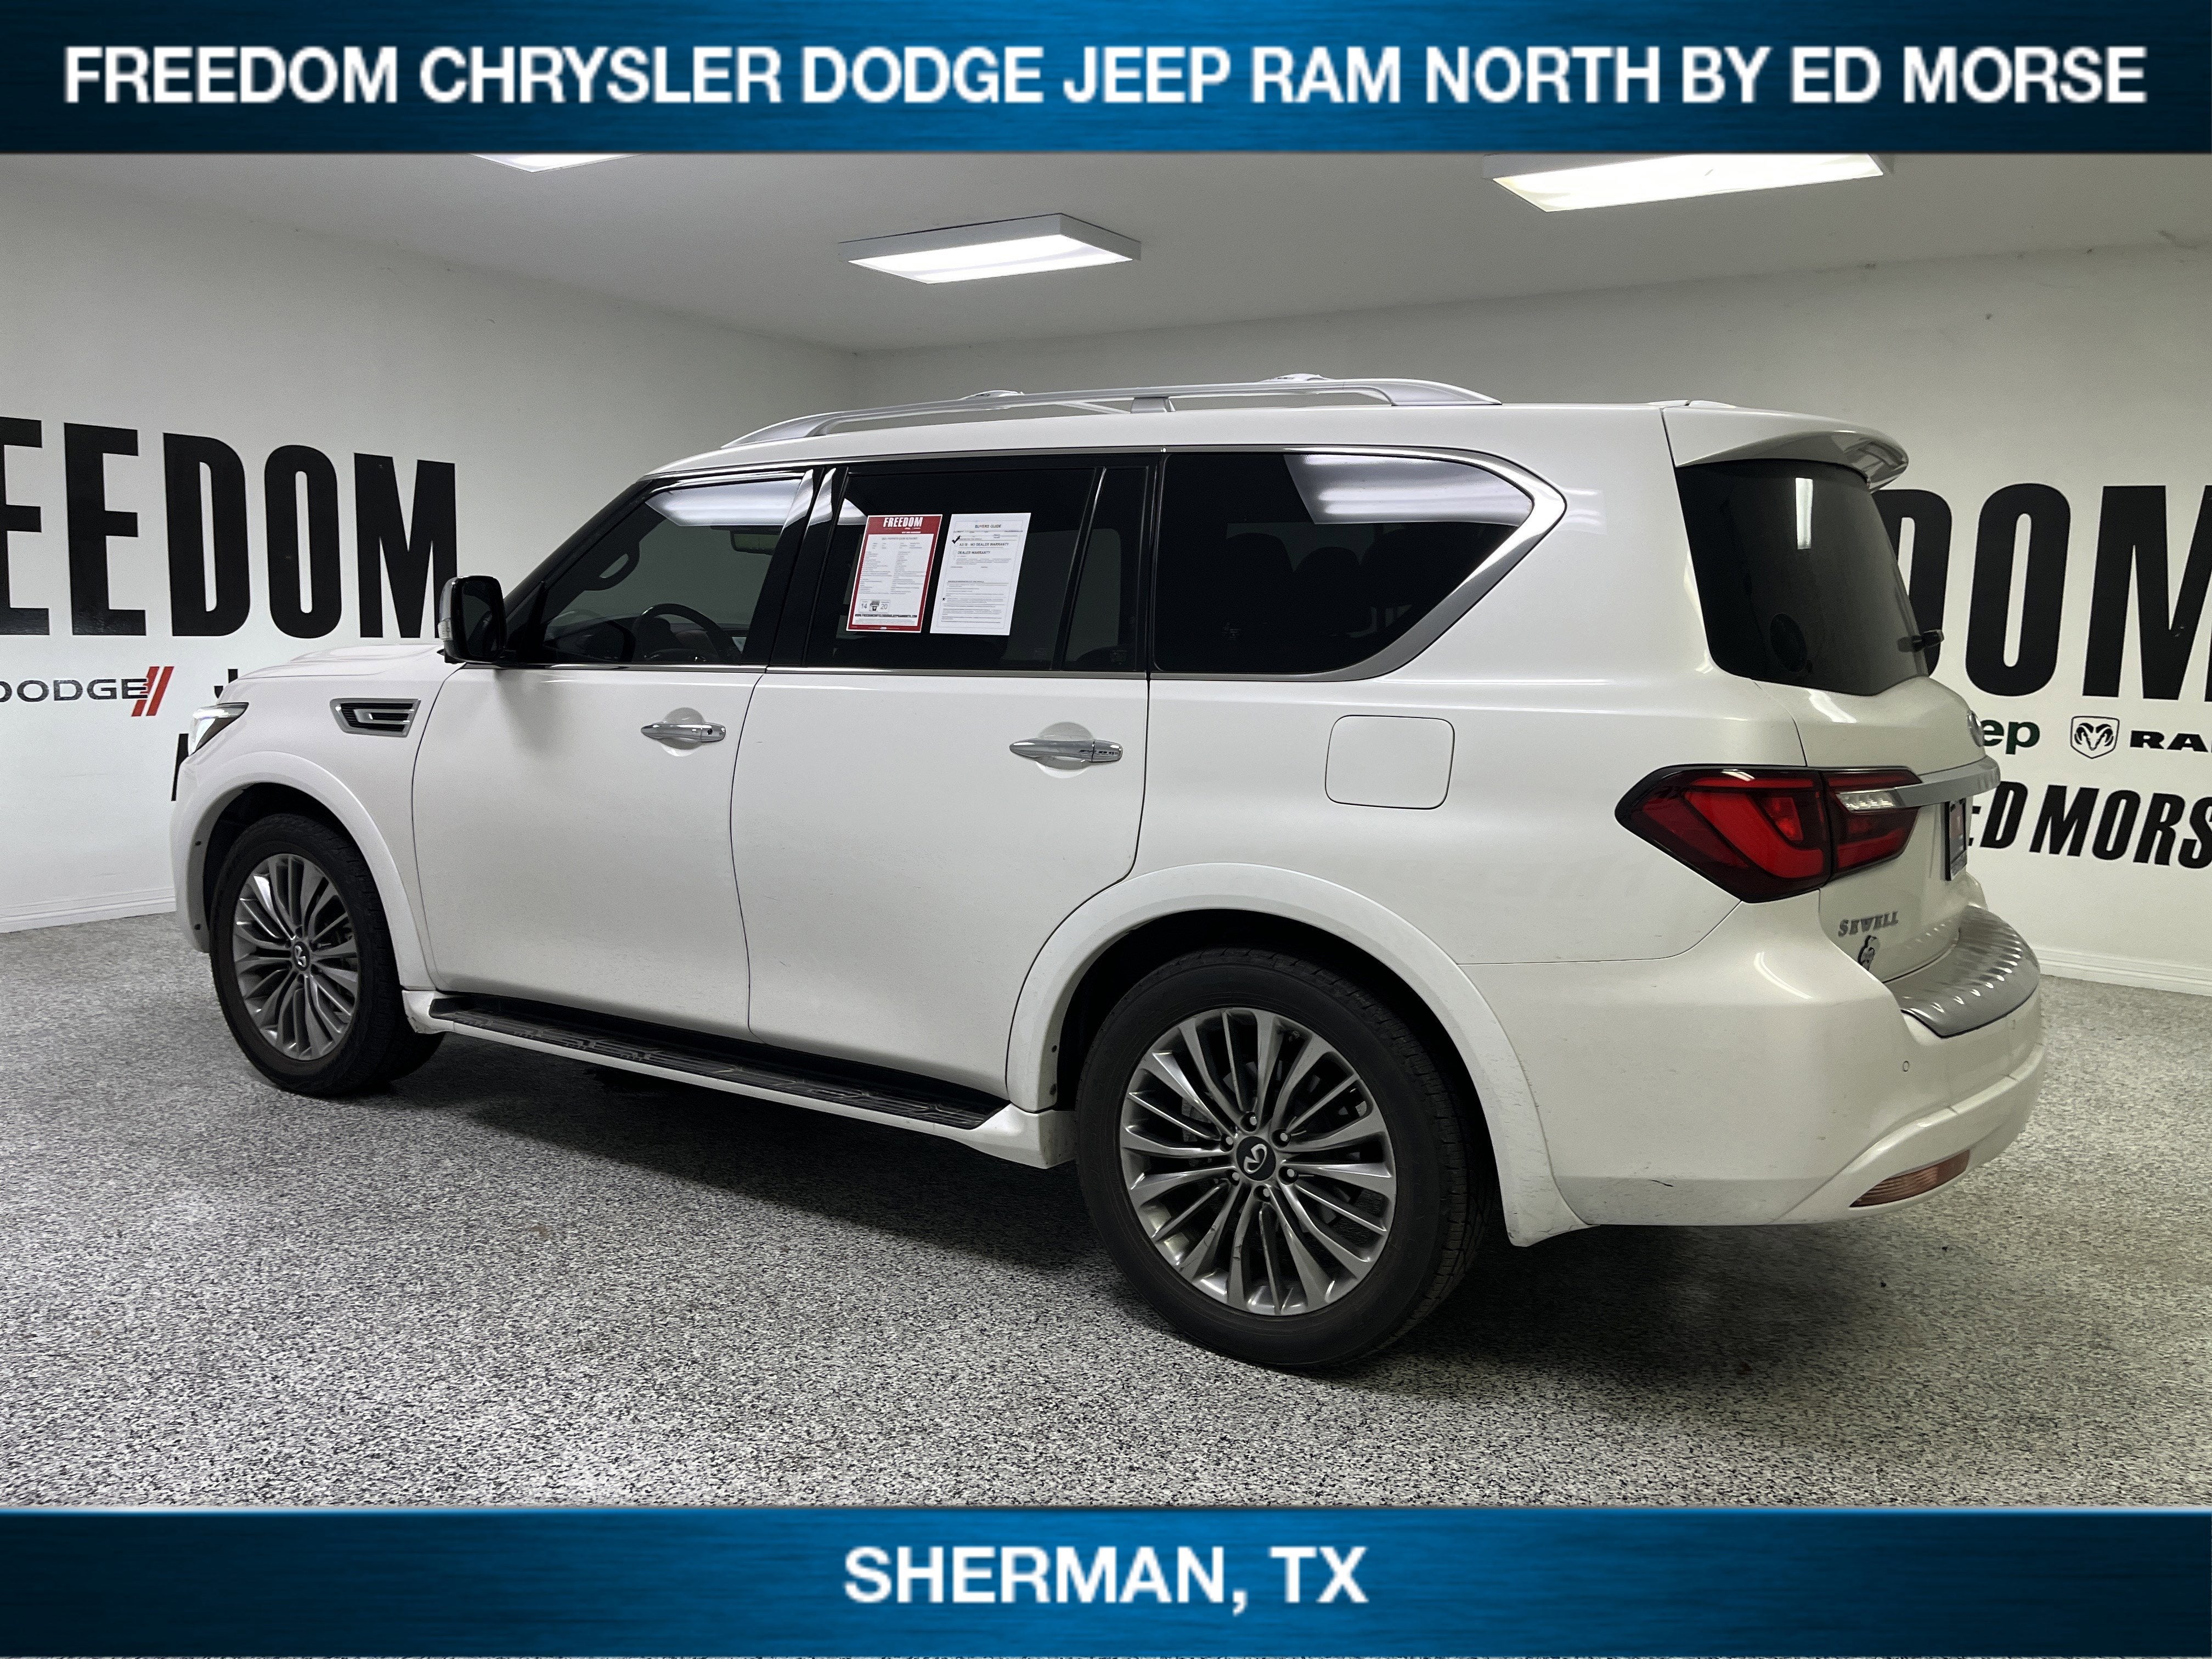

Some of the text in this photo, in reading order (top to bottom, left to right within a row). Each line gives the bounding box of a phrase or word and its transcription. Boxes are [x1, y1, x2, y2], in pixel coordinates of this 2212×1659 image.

[883, 517, 923, 528] FREEDOM
[2130, 730, 2212, 752] RA
[1968, 781, 2028, 849] D
[1838, 911, 1898, 937] SEWELL
